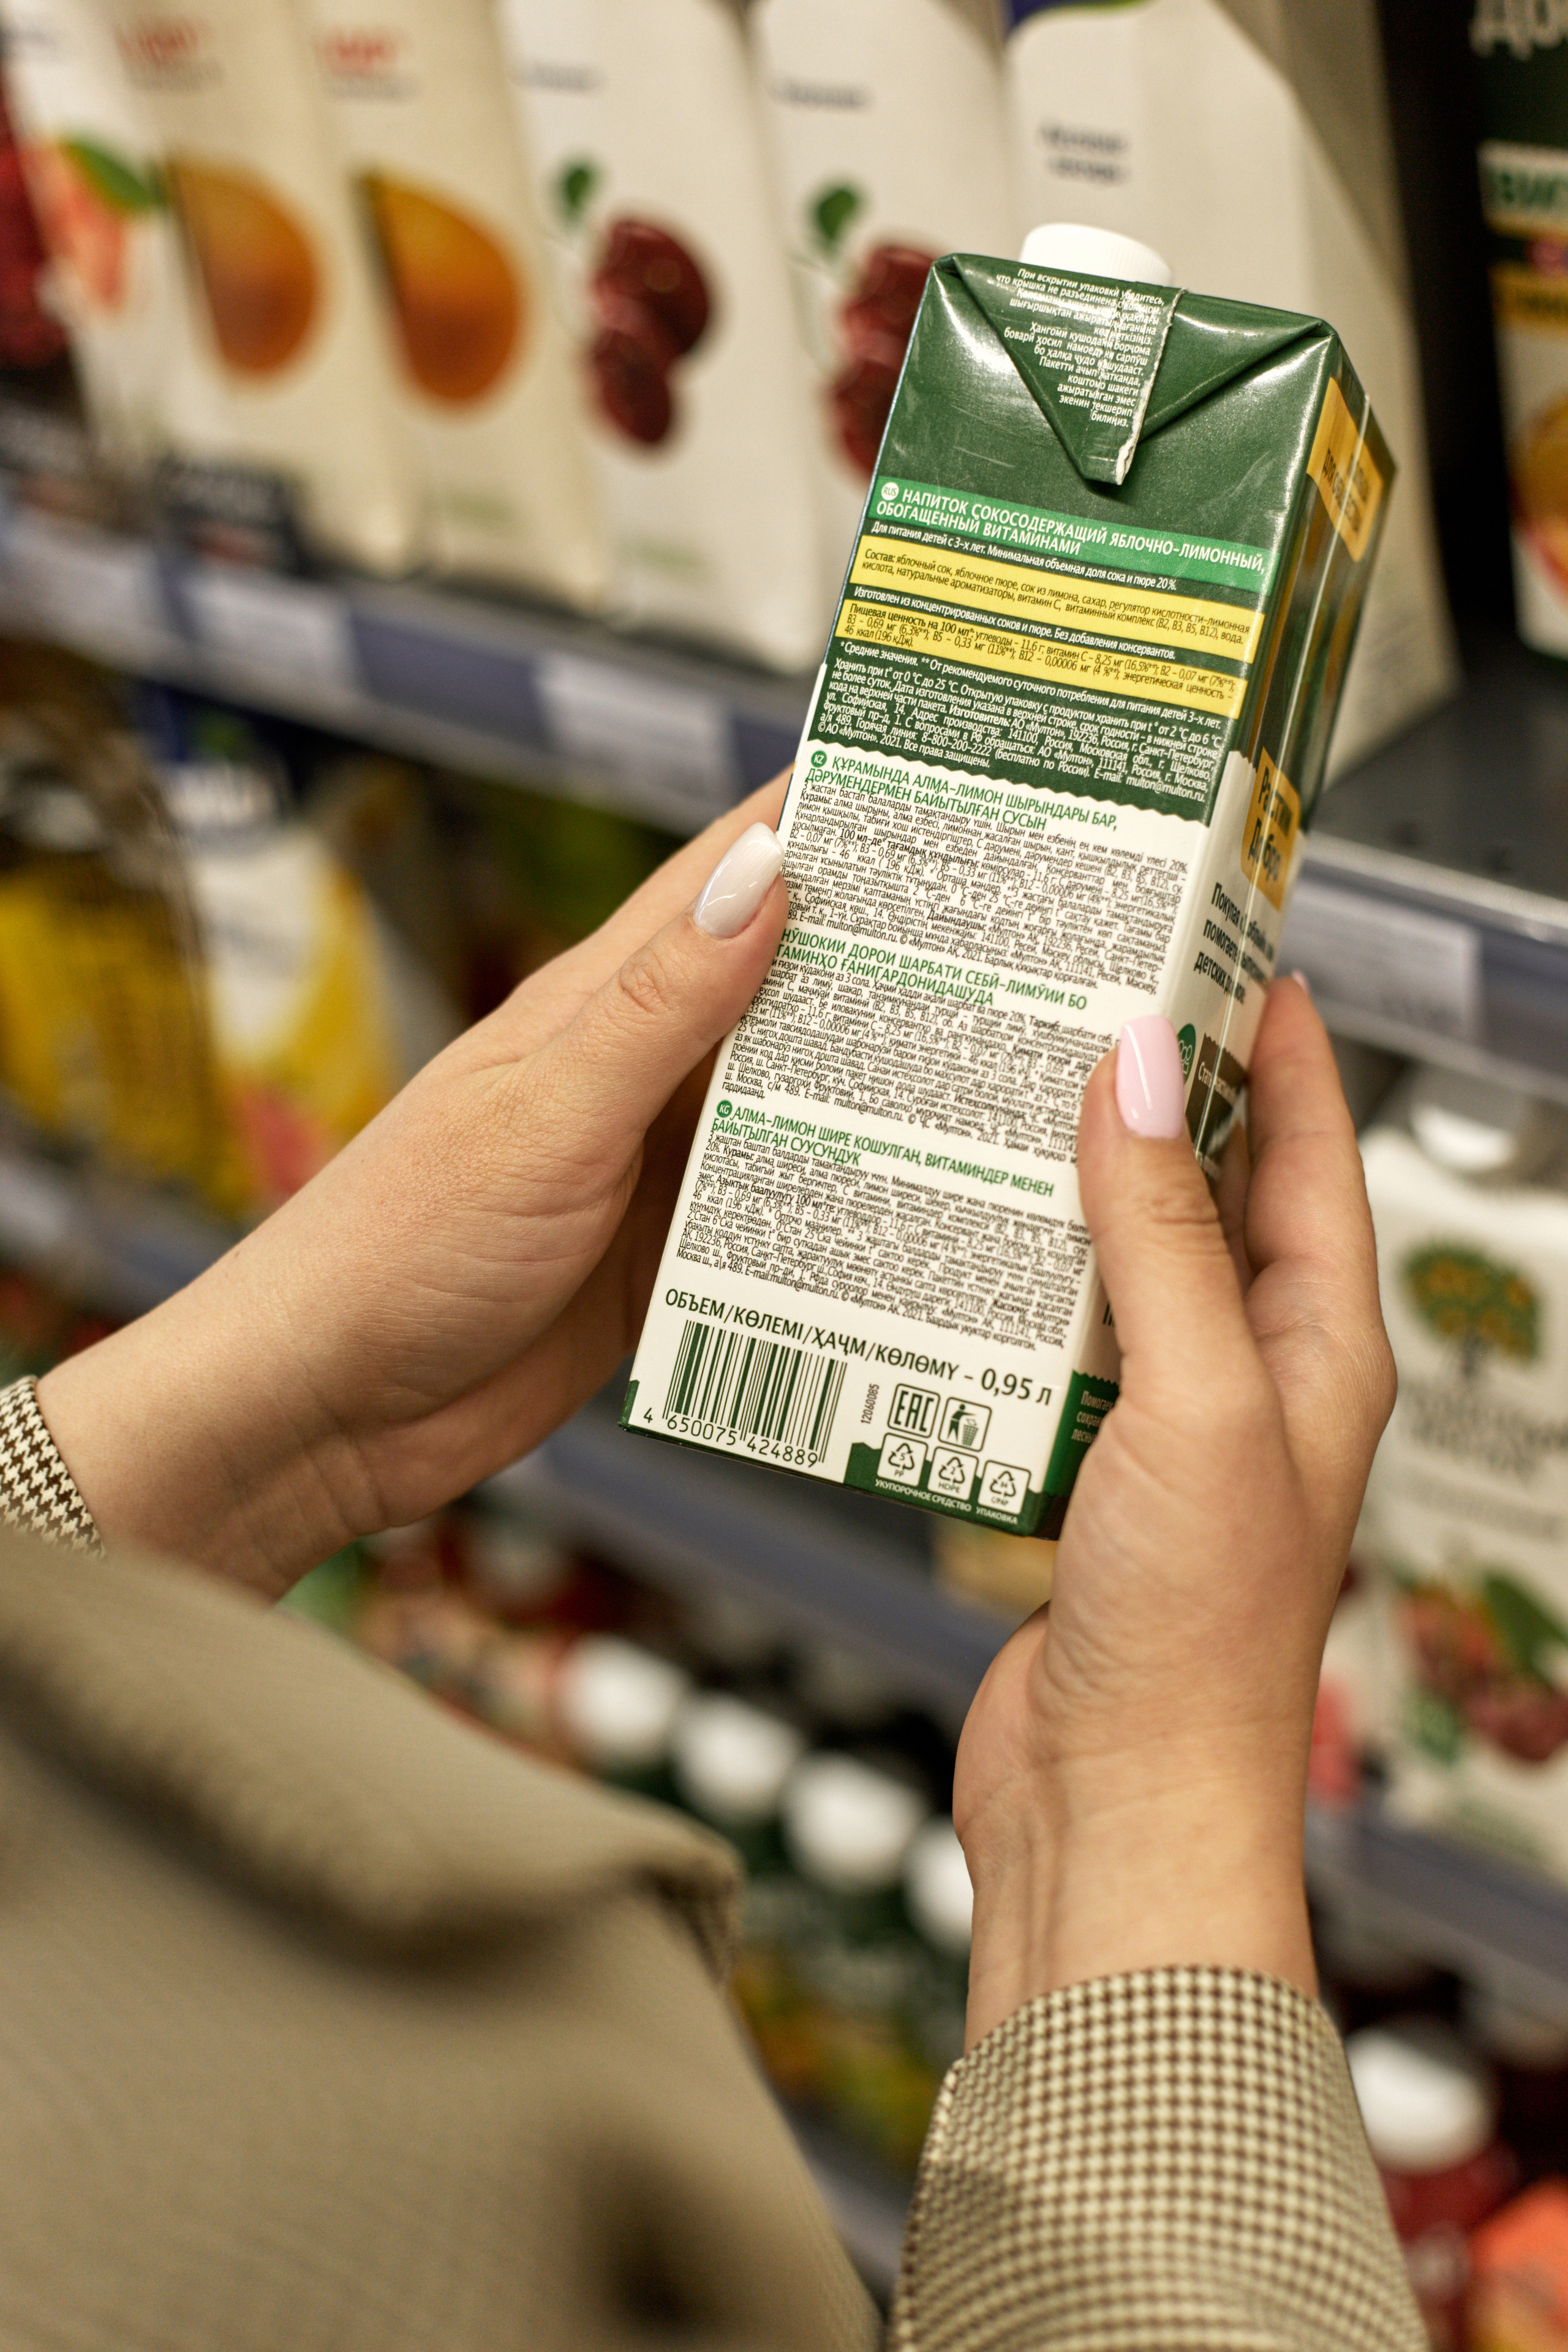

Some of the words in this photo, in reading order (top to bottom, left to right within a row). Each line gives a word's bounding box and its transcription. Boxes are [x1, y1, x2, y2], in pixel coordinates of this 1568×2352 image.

[995, 275, 1011, 285] что
[1011, 278, 1046, 292] крышка
[1046, 285, 1059, 295] не
[1017, 268, 1036, 281] При
[1036, 274, 1078, 289] вскрытии
[1033, 344, 1046, 355] бо
[1038, 356, 1074, 372] Пакетти
[1074, 366, 1097, 377] ачып
[1058, 395, 1090, 409] экенин
[1106, 383, 1139, 397] шакеги
[1114, 396, 1136, 407] эмес
[870, 519, 889, 533] Для
[887, 525, 922, 540] питания
[921, 532, 948, 546] детей
[946, 538, 954, 547] с
[953, 537, 970, 551] 3-х
[969, 543, 986, 554] лет.
[986, 544, 1045, 567] Минимальная
[1084, 567, 1107, 578] доля
[1106, 570, 1127, 582] сока
[1125, 575, 1134, 584] и
[1133, 576, 1156, 589] пюре
[875, 499, 981, 534] ОБОГАЩЕННЫЙ
[982, 522, 1082, 555] ВИТАМИНАМИ
[901, 488, 969, 515] НАПИТОК
[970, 503, 1109, 544] СОКОСОДЕРЖАЩИЙ
[1109, 531, 1267, 574] ЯБЛОЧНО-ЛИМОННЫЙ,
[861, 560, 895, 576] кислота,
[895, 567, 950, 586] натуральные
[949, 578, 1016, 601] ароматизаторы,
[1016, 593, 1053, 608] витамин
[1065, 603, 1117, 620] витаминный
[1115, 612, 1156, 627] комплекс
[864, 547, 897, 563] Состав:
[895, 554, 937, 572] яблочный
[935, 565, 952, 577] сок,
[954, 567, 994, 584] яблочное
[994, 578, 1019, 592] пюре,
[1019, 582, 1036, 594] сок
[1036, 586, 1047, 595] из
[1046, 588, 1080, 603] лимона,
[1080, 595, 1107, 609] сахар,
[1108, 600, 1152, 617] регулятор
[853, 584, 900, 604] Изготовлен
[899, 597, 911, 606] из
[910, 598, 997, 625] концентрированных
[995, 617, 1022, 631] соков
[1020, 623, 1028, 632] и
[1027, 624, 1052, 638] пюре.
[1053, 627, 1069, 640] Без
[1068, 631, 1118, 649] добавления
[1117, 641, 1175, 660] консервантов.
[843, 640, 880, 658] Средние
[878, 650, 918, 666] значения.
[928, 658, 943, 671] От
[941, 663, 1014, 687] рекомендуемого
[1012, 679, 1057, 696] суточного
[1055, 688, 1110, 706] потребления
[1108, 698, 1126, 709] для
[1125, 701, 1161, 716] питания
[1159, 708, 1188, 722] детей
[1186, 711, 1205, 725] 3-х
[1203, 717, 1221, 728] лет.
[820, 710, 833, 723] а/я
[834, 712, 852, 726] 489.
[855, 717, 888, 734] Горячая
[889, 726, 919, 741] линия:
[920, 731, 993, 756] 8-800-200-2222
[993, 747, 1041, 767] (бесплатно
[1042, 760, 1056, 770] по
[1057, 760, 1090, 778] России).
[1093, 767, 1124, 783] E-mail:
[1125, 776, 1206, 802] multon@multon.ru.
[831, 755, 912, 785] ҚҰРАМЫНДА
[911, 773, 1004, 805] АЛМА-ЛИМОН
[1005, 793, 1090, 823] ШЫРЫНДАРЫ
[1090, 811, 1117, 832] БАР,
[710, 1117, 789, 1148] БАЙЫТЫЛГАН
[789, 1136, 862, 1166] СУУСУНДУК
[731, 1106, 817, 1138] АЛМА-ЛИМОН
[817, 1126, 853, 1147] ШИРЕ
[853, 1134, 921, 1167] КОШУЛГАН,
[924, 1152, 1010, 1186] ВИТАМИНДЕР
[1009, 1173, 1055, 1197] МЕНЕН
[979, 1368, 1033, 1401] 0,95
[1036, 1387, 1052, 1406] л
[642, 1407, 655, 1423] 4
[666, 1413, 739, 1447] 650075
[745, 1434, 819, 1469] 424889
